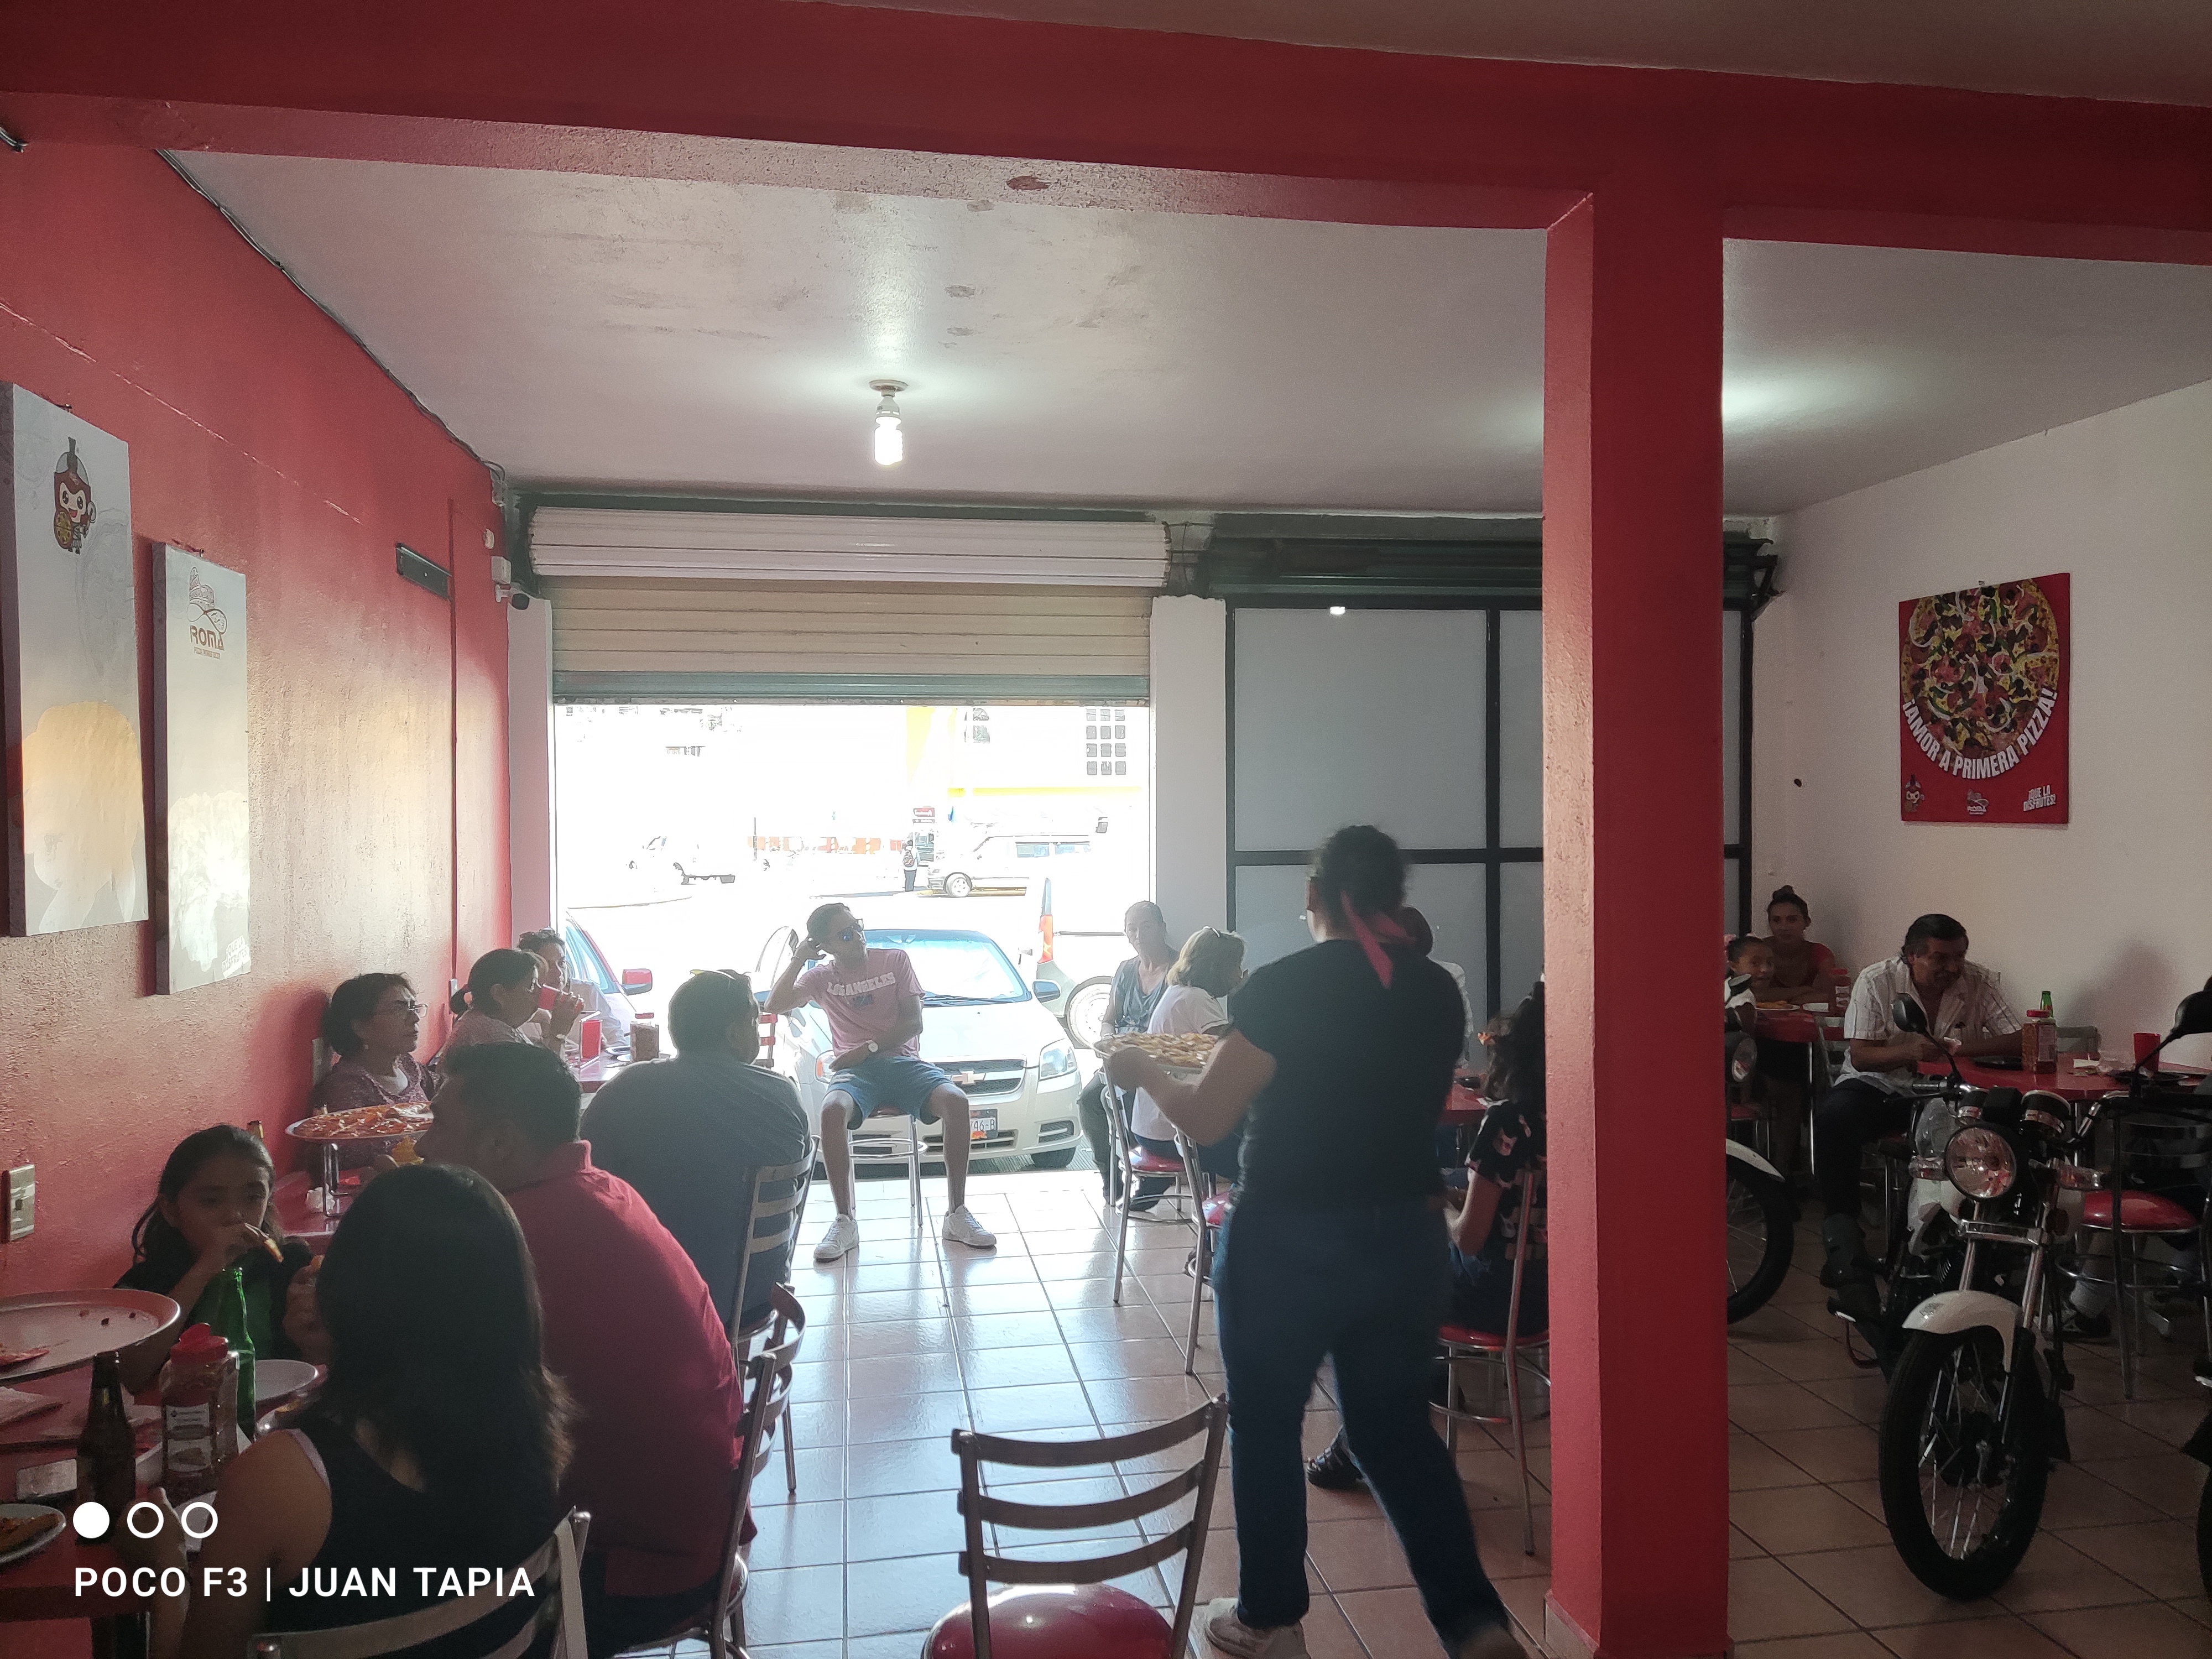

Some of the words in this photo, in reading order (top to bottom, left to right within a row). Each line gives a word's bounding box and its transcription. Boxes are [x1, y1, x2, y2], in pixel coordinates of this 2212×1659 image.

[190, 624, 225, 651] ROMA
[1902, 698, 1940, 762] ¡AMOR
[1939, 750, 1952, 771] A
[1953, 745, 2020, 779] PRIMERA
[2017, 687, 2058, 756] PIZZA!
[845, 972, 895, 996] ANGELES
